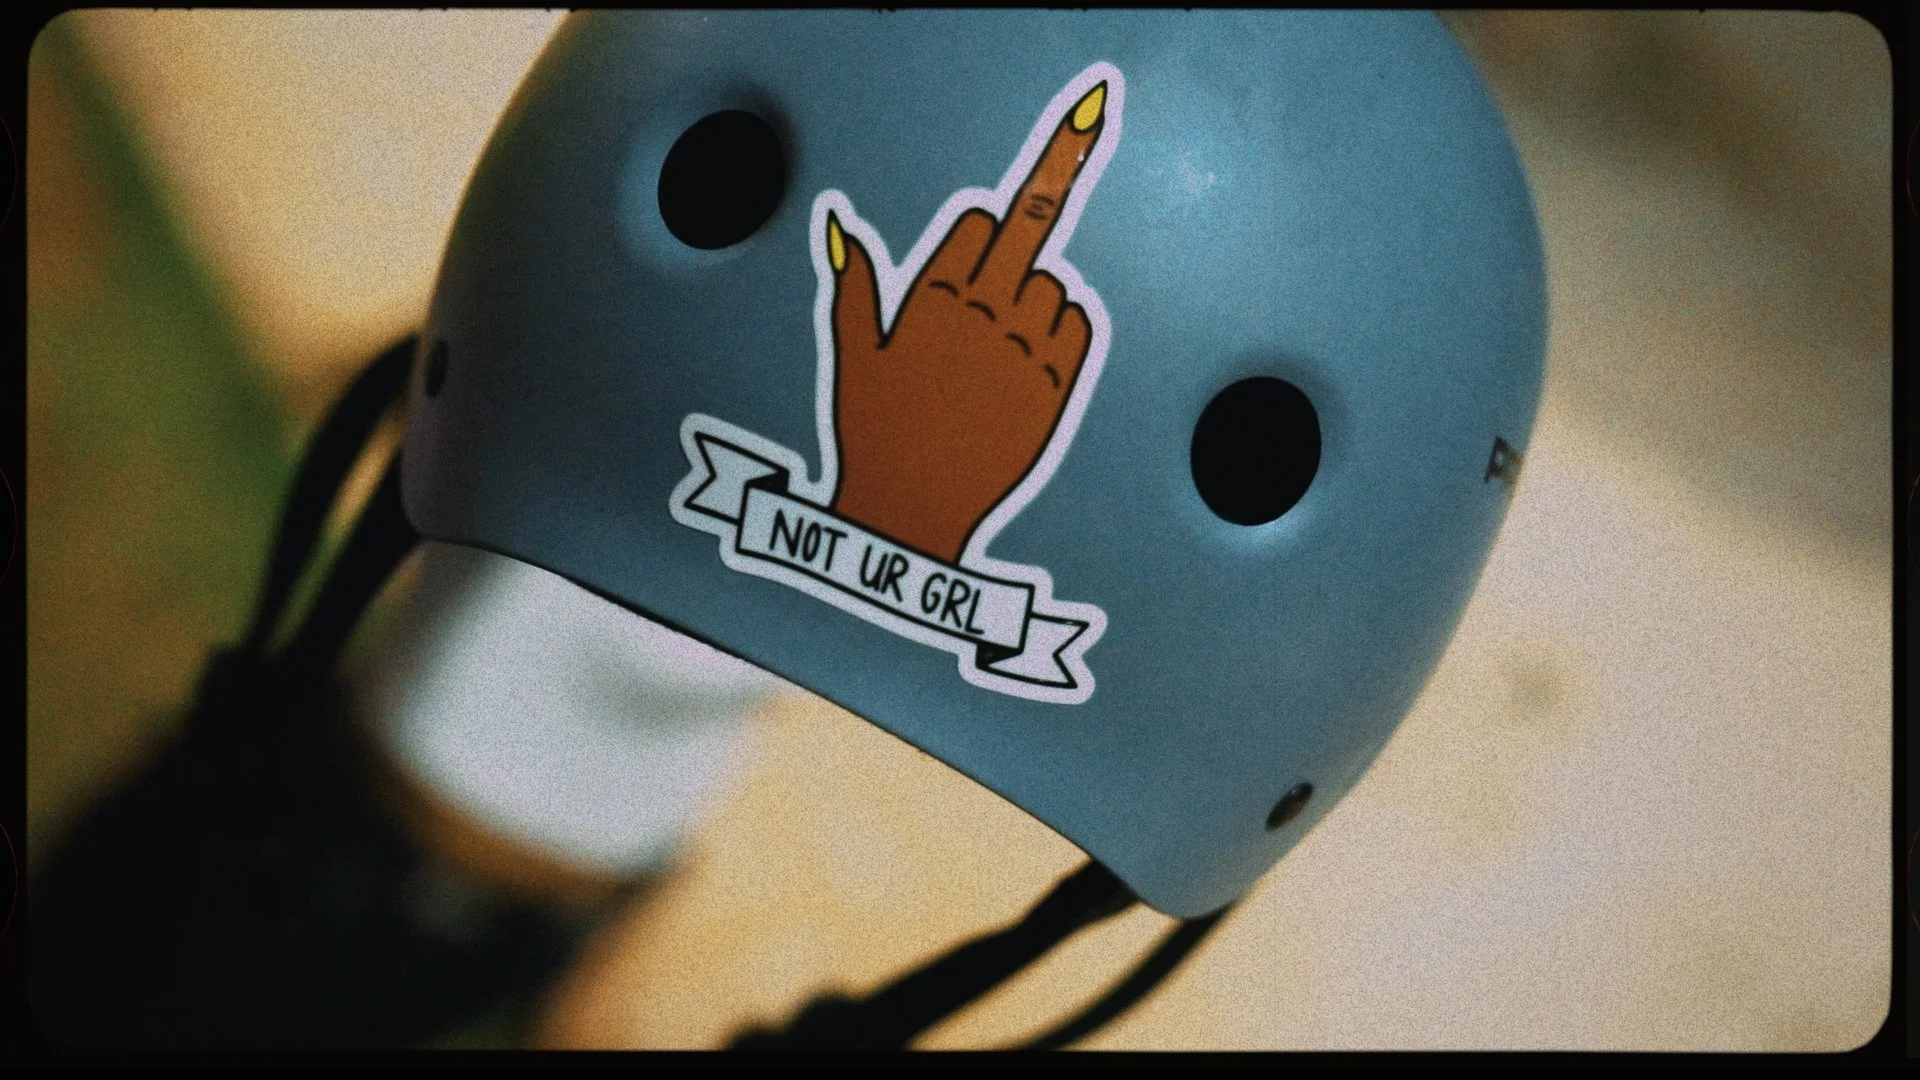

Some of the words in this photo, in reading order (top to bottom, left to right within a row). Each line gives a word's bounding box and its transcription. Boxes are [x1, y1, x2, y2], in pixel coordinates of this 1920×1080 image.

[769, 508, 848, 571] NOT
[860, 545, 909, 602] UR
[921, 572, 985, 635] GRL
